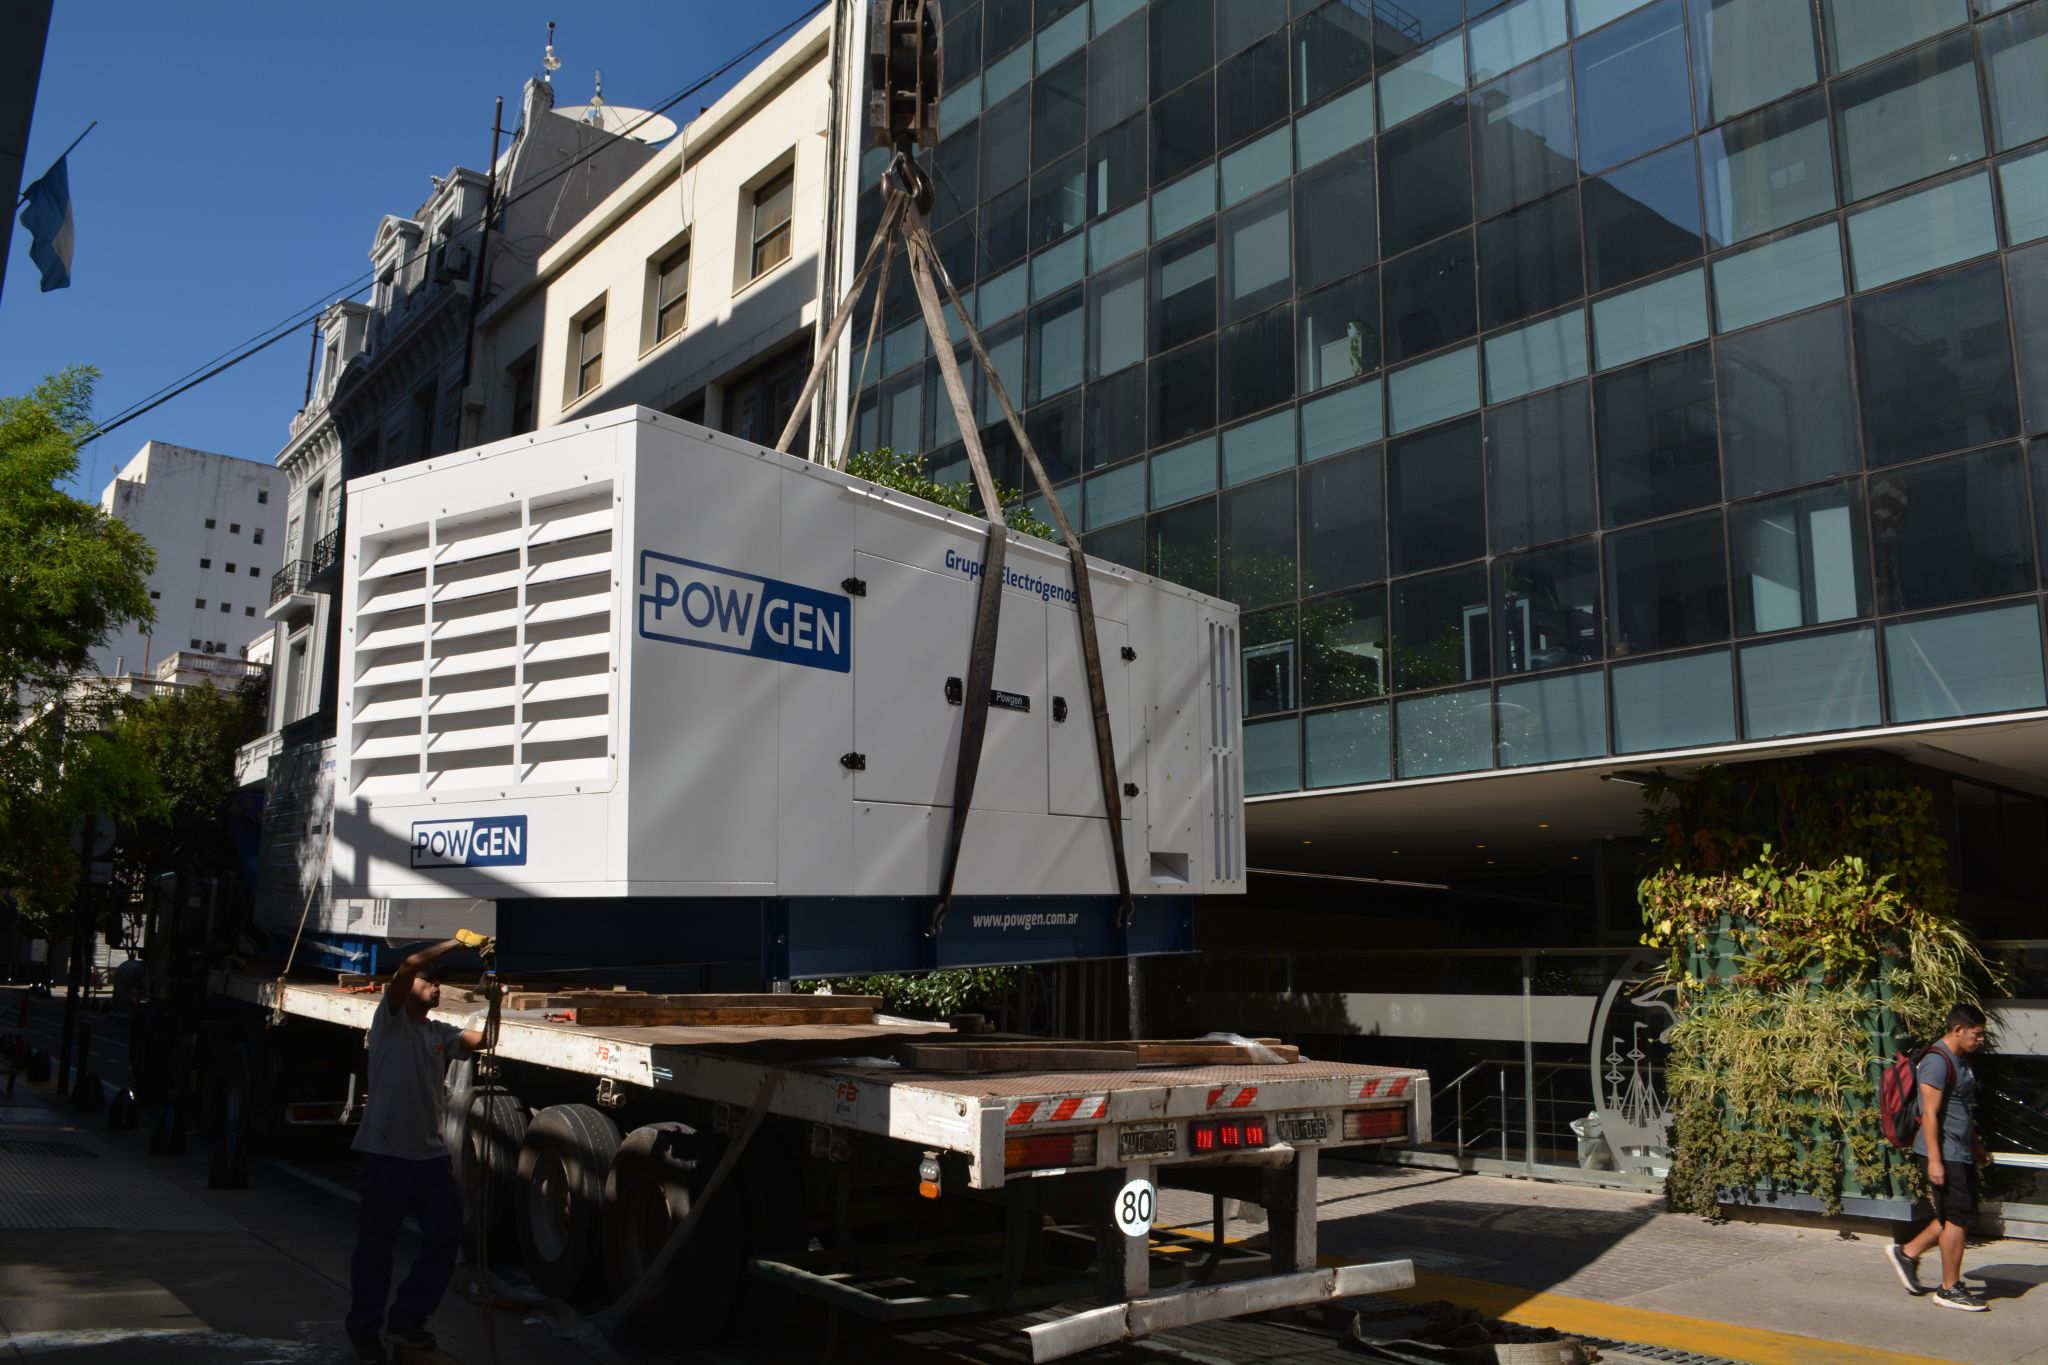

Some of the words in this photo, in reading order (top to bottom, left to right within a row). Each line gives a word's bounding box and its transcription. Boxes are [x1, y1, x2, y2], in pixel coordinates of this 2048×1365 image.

[654, 572, 841, 656] POWGEN
[996, 691, 1023, 706] Powgen
[417, 826, 521, 859] POWGEN
[973, 913, 1079, 931] www.powgen.com.ar
[1305, 1120, 1326, 1138] 036
[1122, 1188, 1152, 1225] 80
